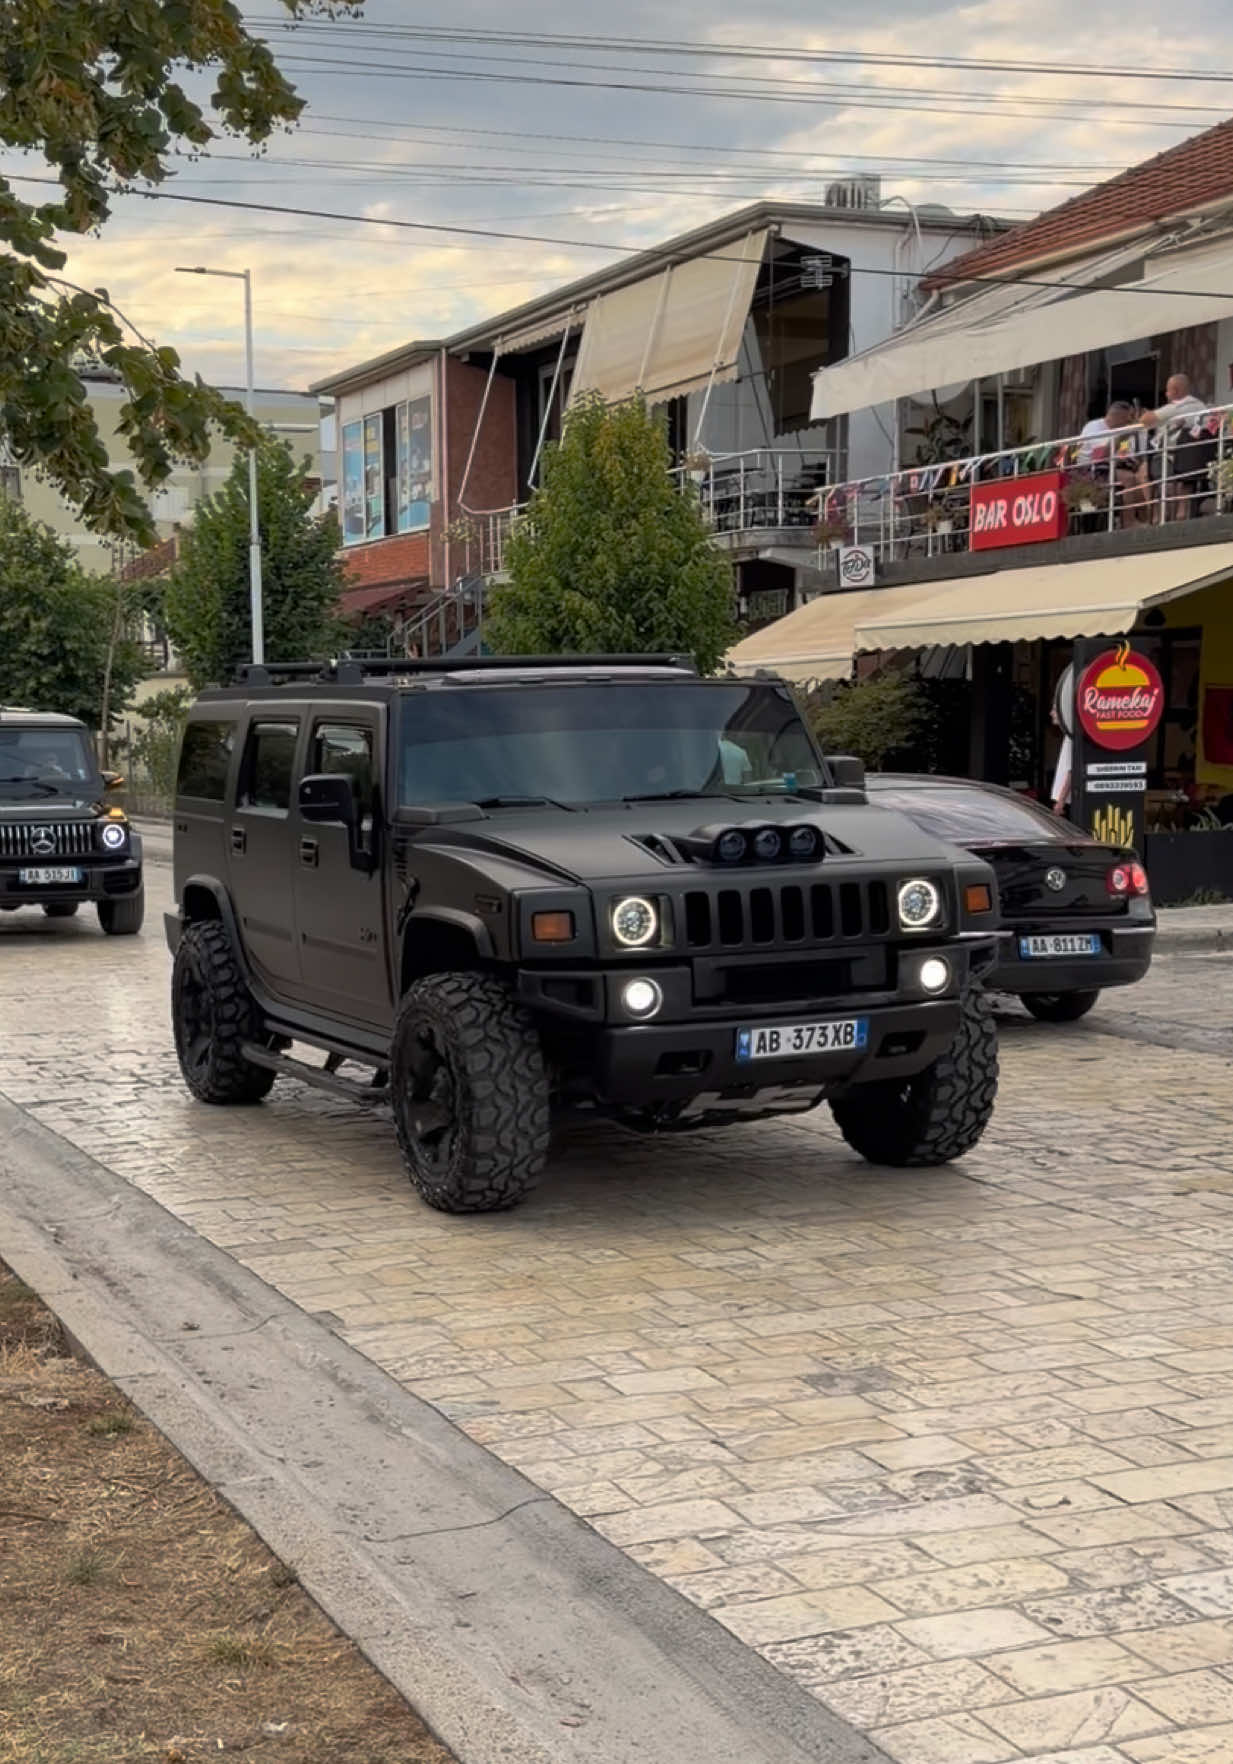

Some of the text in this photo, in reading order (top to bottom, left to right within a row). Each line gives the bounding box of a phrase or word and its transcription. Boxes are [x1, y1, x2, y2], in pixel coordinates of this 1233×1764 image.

[974, 490, 1057, 533] BAR OSLO
[1084, 686, 1159, 718] Ramekaj
[1096, 710, 1116, 720] FAST
[1032, 938, 1048, 953] AA
[755, 1022, 855, 1055] AB 373XB
